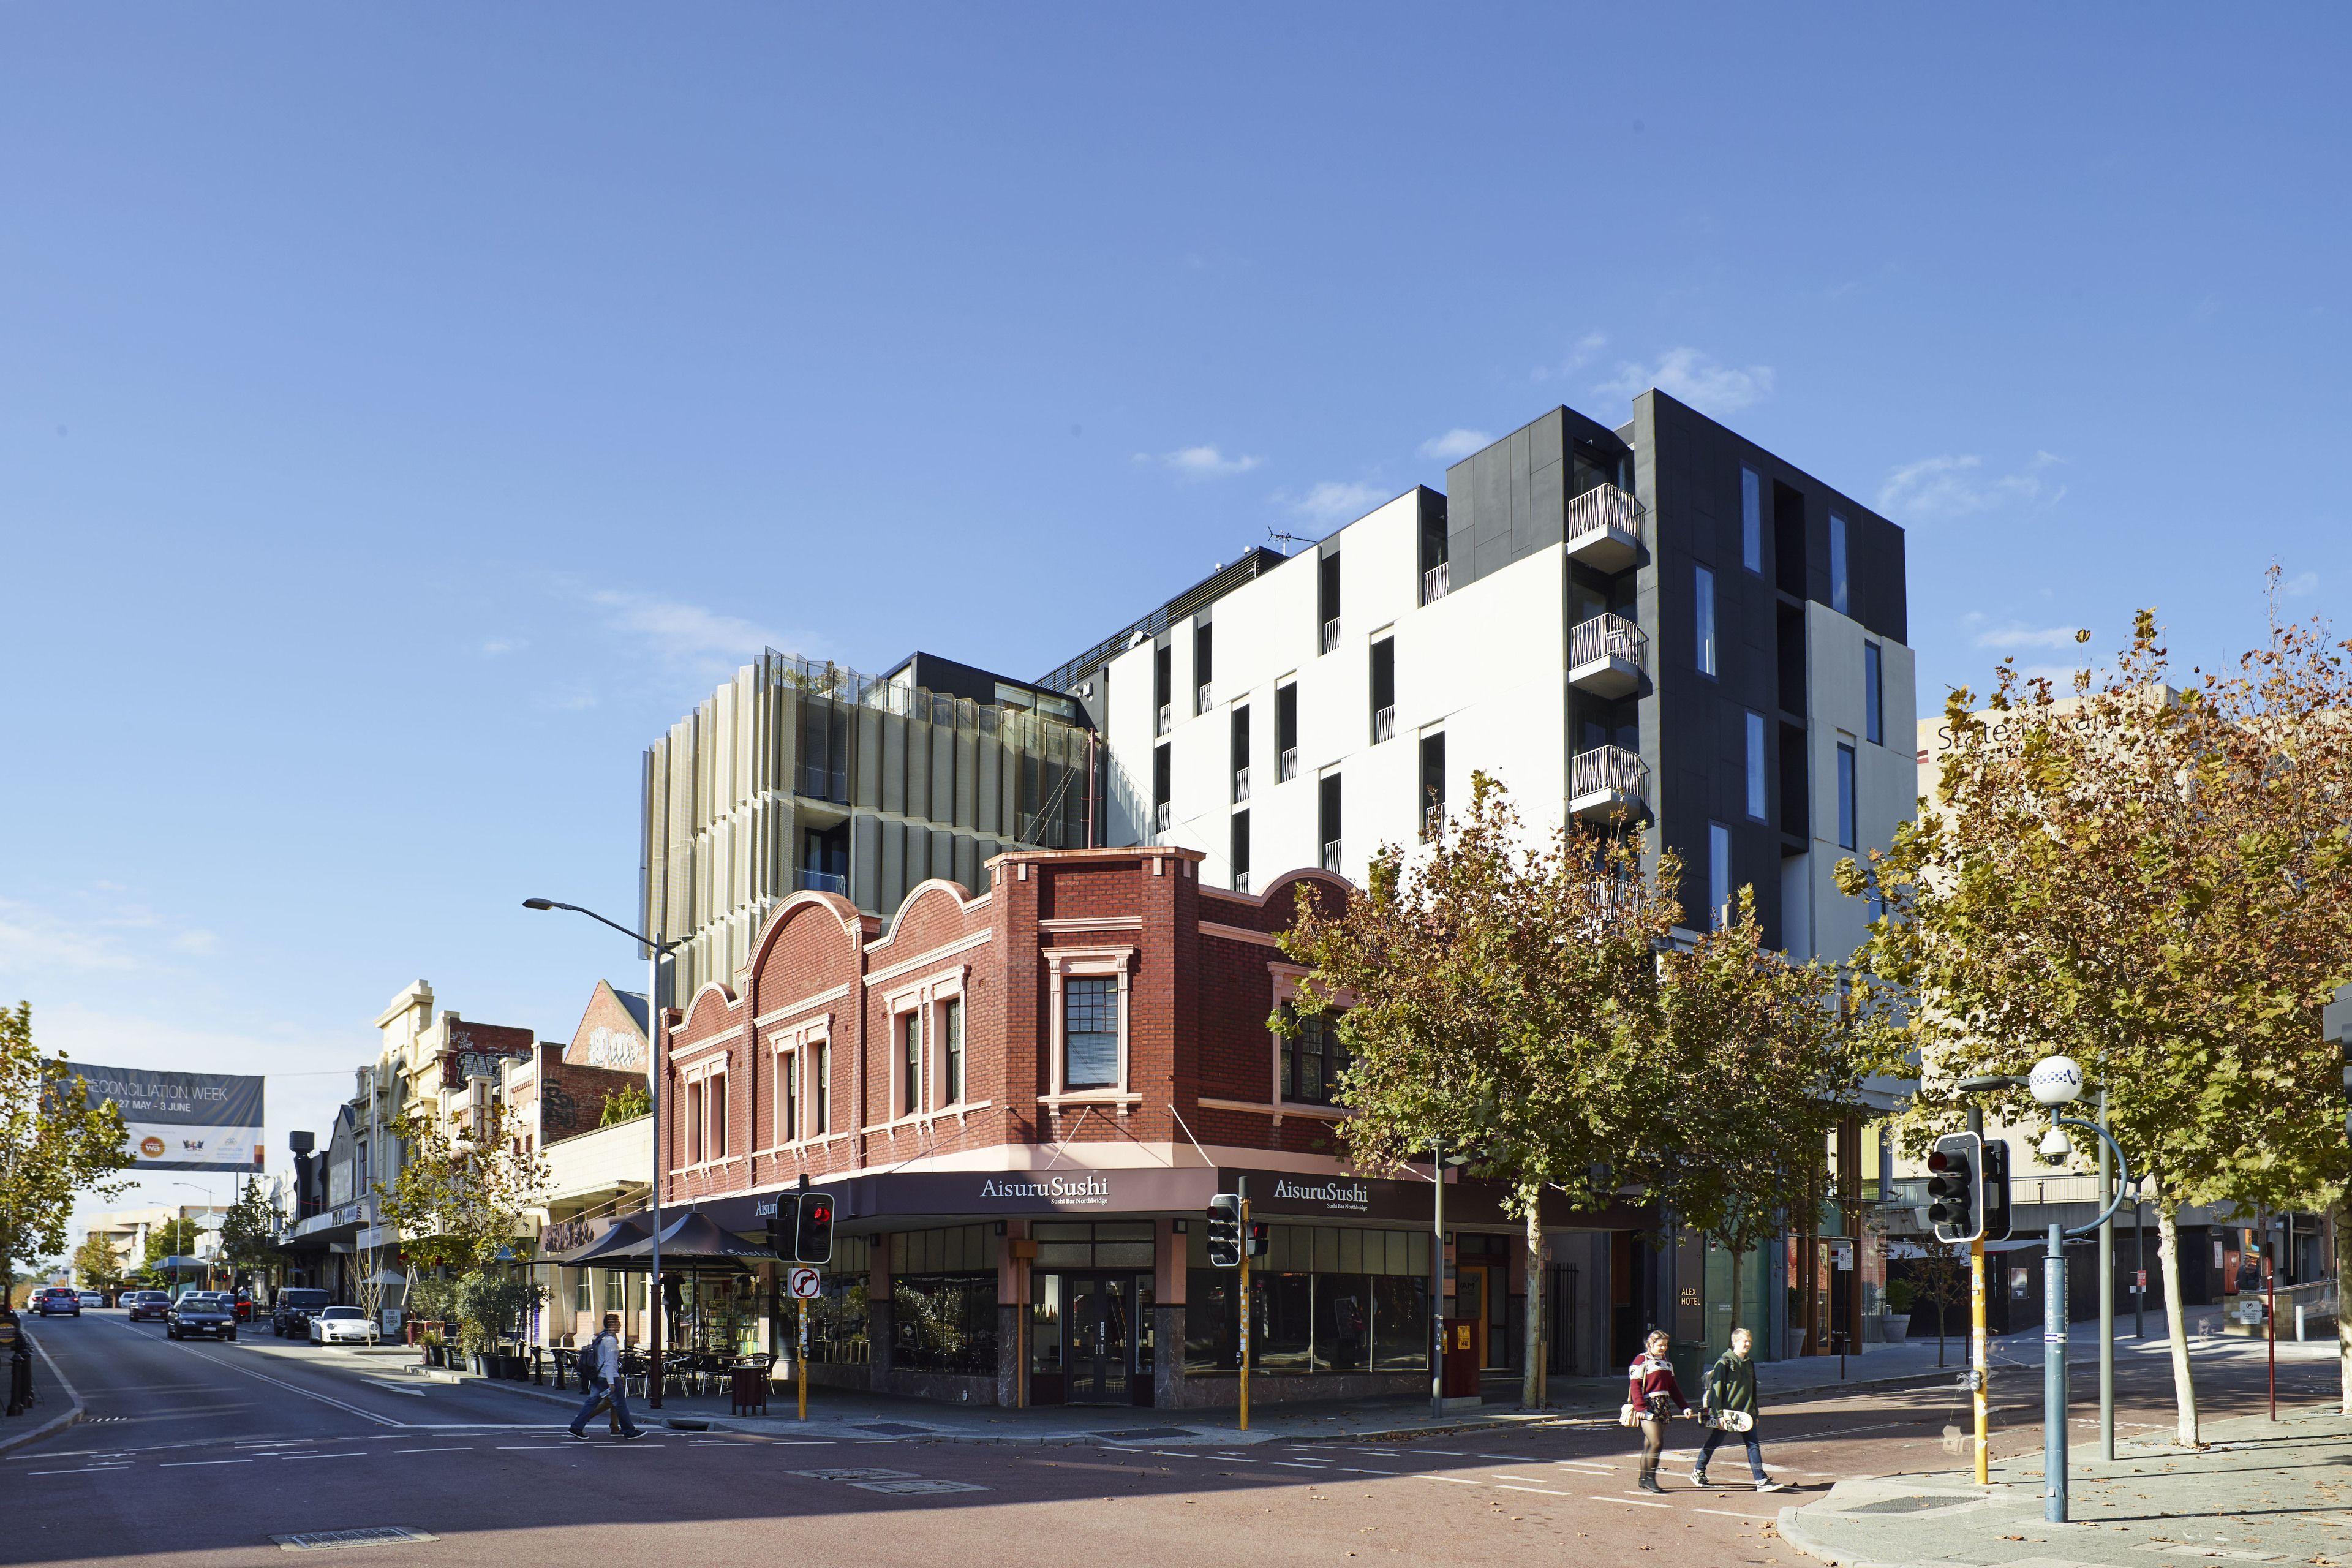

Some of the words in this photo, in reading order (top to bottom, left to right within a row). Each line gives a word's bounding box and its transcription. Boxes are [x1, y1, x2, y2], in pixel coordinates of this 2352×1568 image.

[191, 1087, 228, 1101] WEEK
[118, 1099, 130, 1109] 27
[132, 1101, 152, 1110] MAY
[168, 1103, 191, 1112] JUNE
[755, 1200, 777, 1216] Aisur
